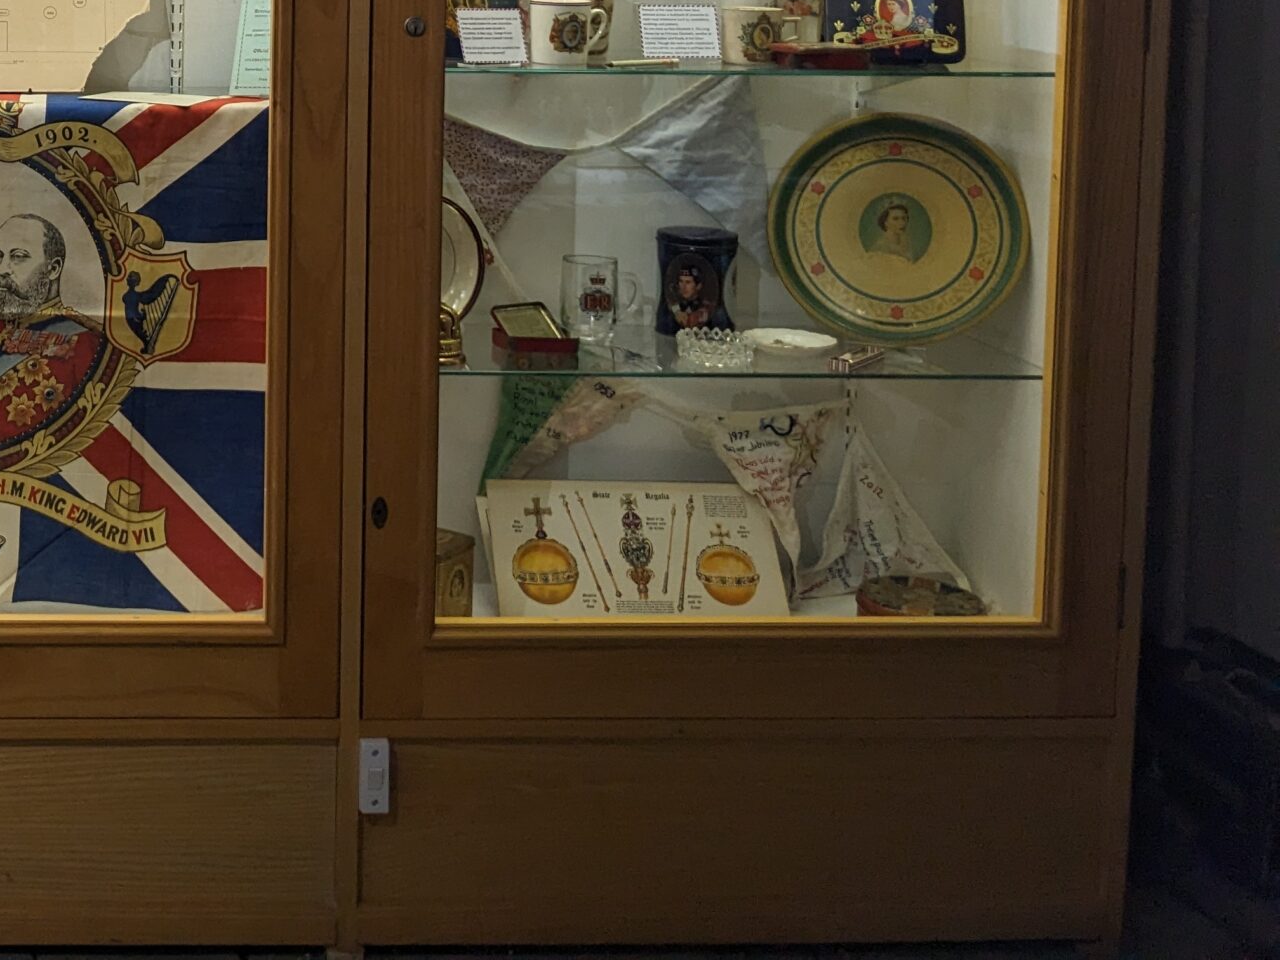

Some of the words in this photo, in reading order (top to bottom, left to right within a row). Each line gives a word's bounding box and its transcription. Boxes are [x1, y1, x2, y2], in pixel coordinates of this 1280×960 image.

[34, 126, 97, 148] 1902.
[728, 429, 750, 443] 1977
[645, 491, 670, 501] Regalia
[859, 474, 884, 499] 2012
[28, 485, 67, 516] KING
[66, 503, 129, 545] EDWARD
[131, 526, 156, 545] VII
